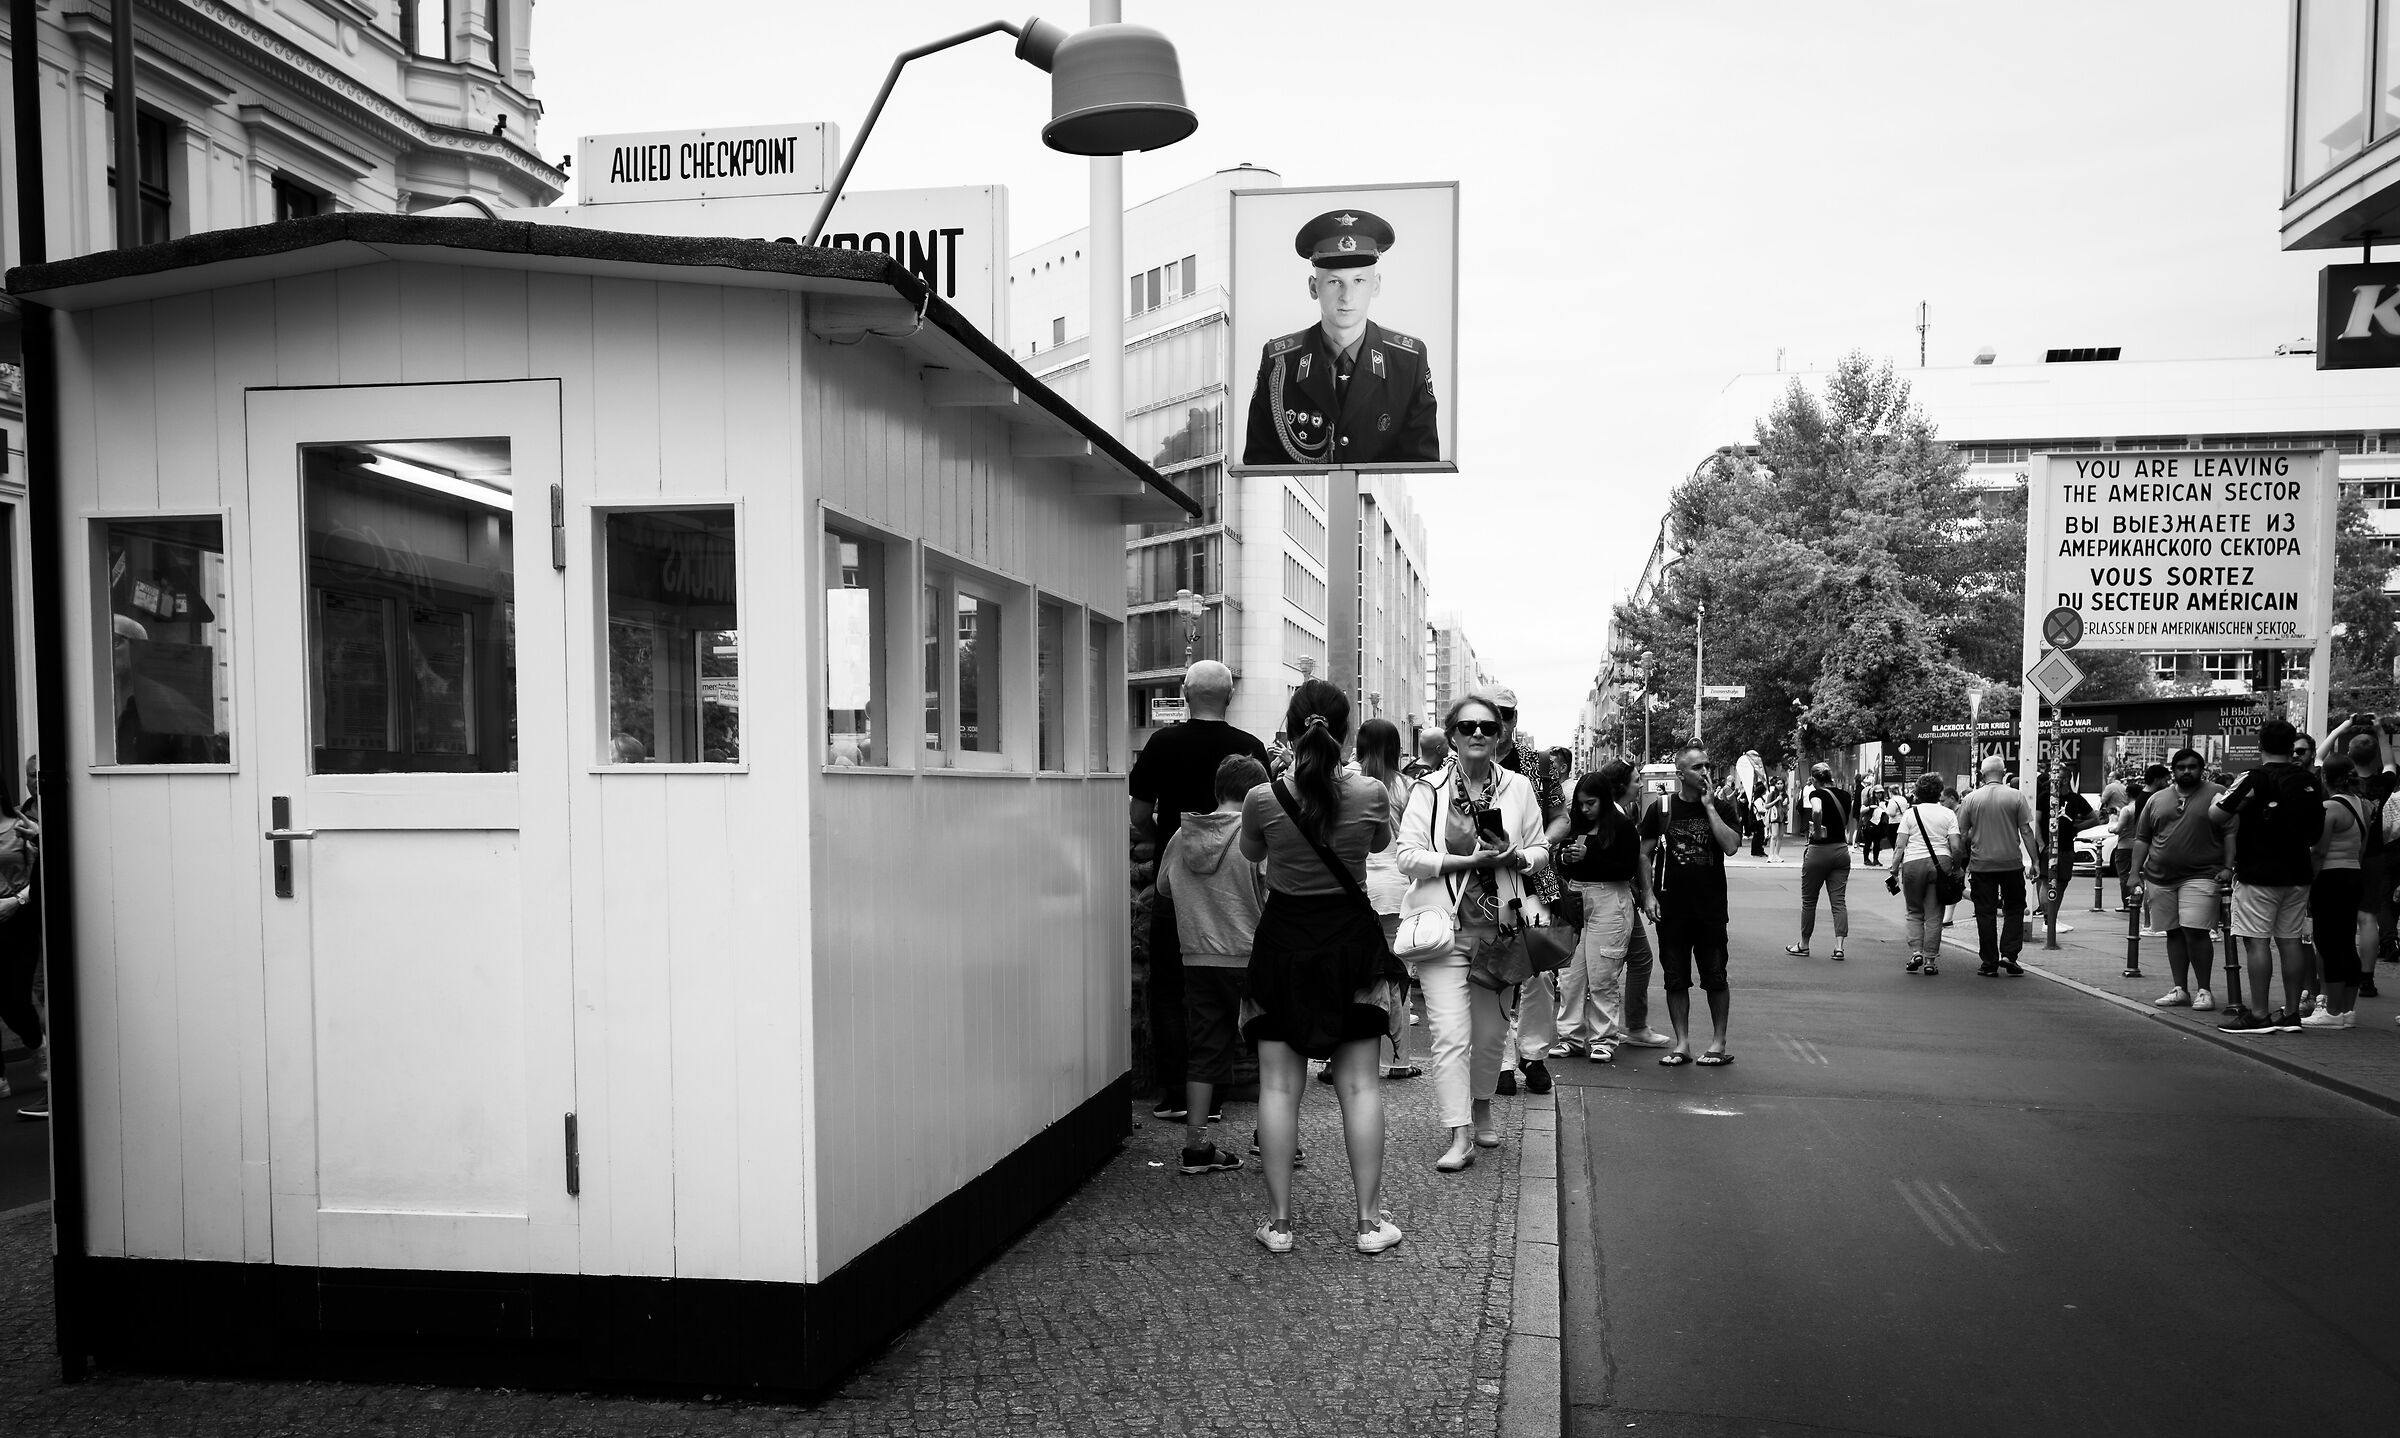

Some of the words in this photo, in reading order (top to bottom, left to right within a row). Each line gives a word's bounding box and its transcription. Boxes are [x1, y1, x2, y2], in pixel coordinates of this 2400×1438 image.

[610, 144, 671, 184] ALLIED
[680, 135, 798, 180] CHECKPOINT
[2075, 459, 2121, 479] YOU
[2134, 458, 2179, 478] ARE
[2193, 456, 2290, 477] LEAVING
[2063, 484, 2097, 503] THE
[2108, 483, 2212, 502] AMERICAN
[2224, 481, 2301, 501] SECTOR
[2065, 516, 2099, 534] ВЫ
[2113, 514, 2251, 534] ВЫЕЗЖАЕТЕ
[2266, 512, 2296, 533] ИЗ
[2058, 538, 2212, 557] АМЕРИКАНСКОГО
[2220, 537, 2301, 557] СЕКТОРА
[2090, 567, 2153, 587] VOUS
[2166, 566, 2255, 587] SORTEZ
[2057, 592, 2083, 611] DU
[2091, 591, 2179, 611] SECTEUR
[2186, 588, 2298, 611] AMÉRICAIN
[2083, 621, 2135, 636] ERLASSEN
[2137, 621, 2158, 635] DEN
[2161, 621, 2253, 636] AMERIKANISCHEN
[2256, 621, 2297, 635] SEKTOR
[1932, 723, 1965, 733] BLACKBOX
[1966, 722, 1990, 732] KTER
[1990, 721, 2010, 730] KRIEG
[2059, 719, 2074, 728] OLD
[2074, 718, 2092, 727] WAR
[1917, 731, 1950, 739] AUSSTELLUNG
[1959, 730, 1989, 738] CHECOINT
[1989, 729, 2010, 737] CHARLIE
